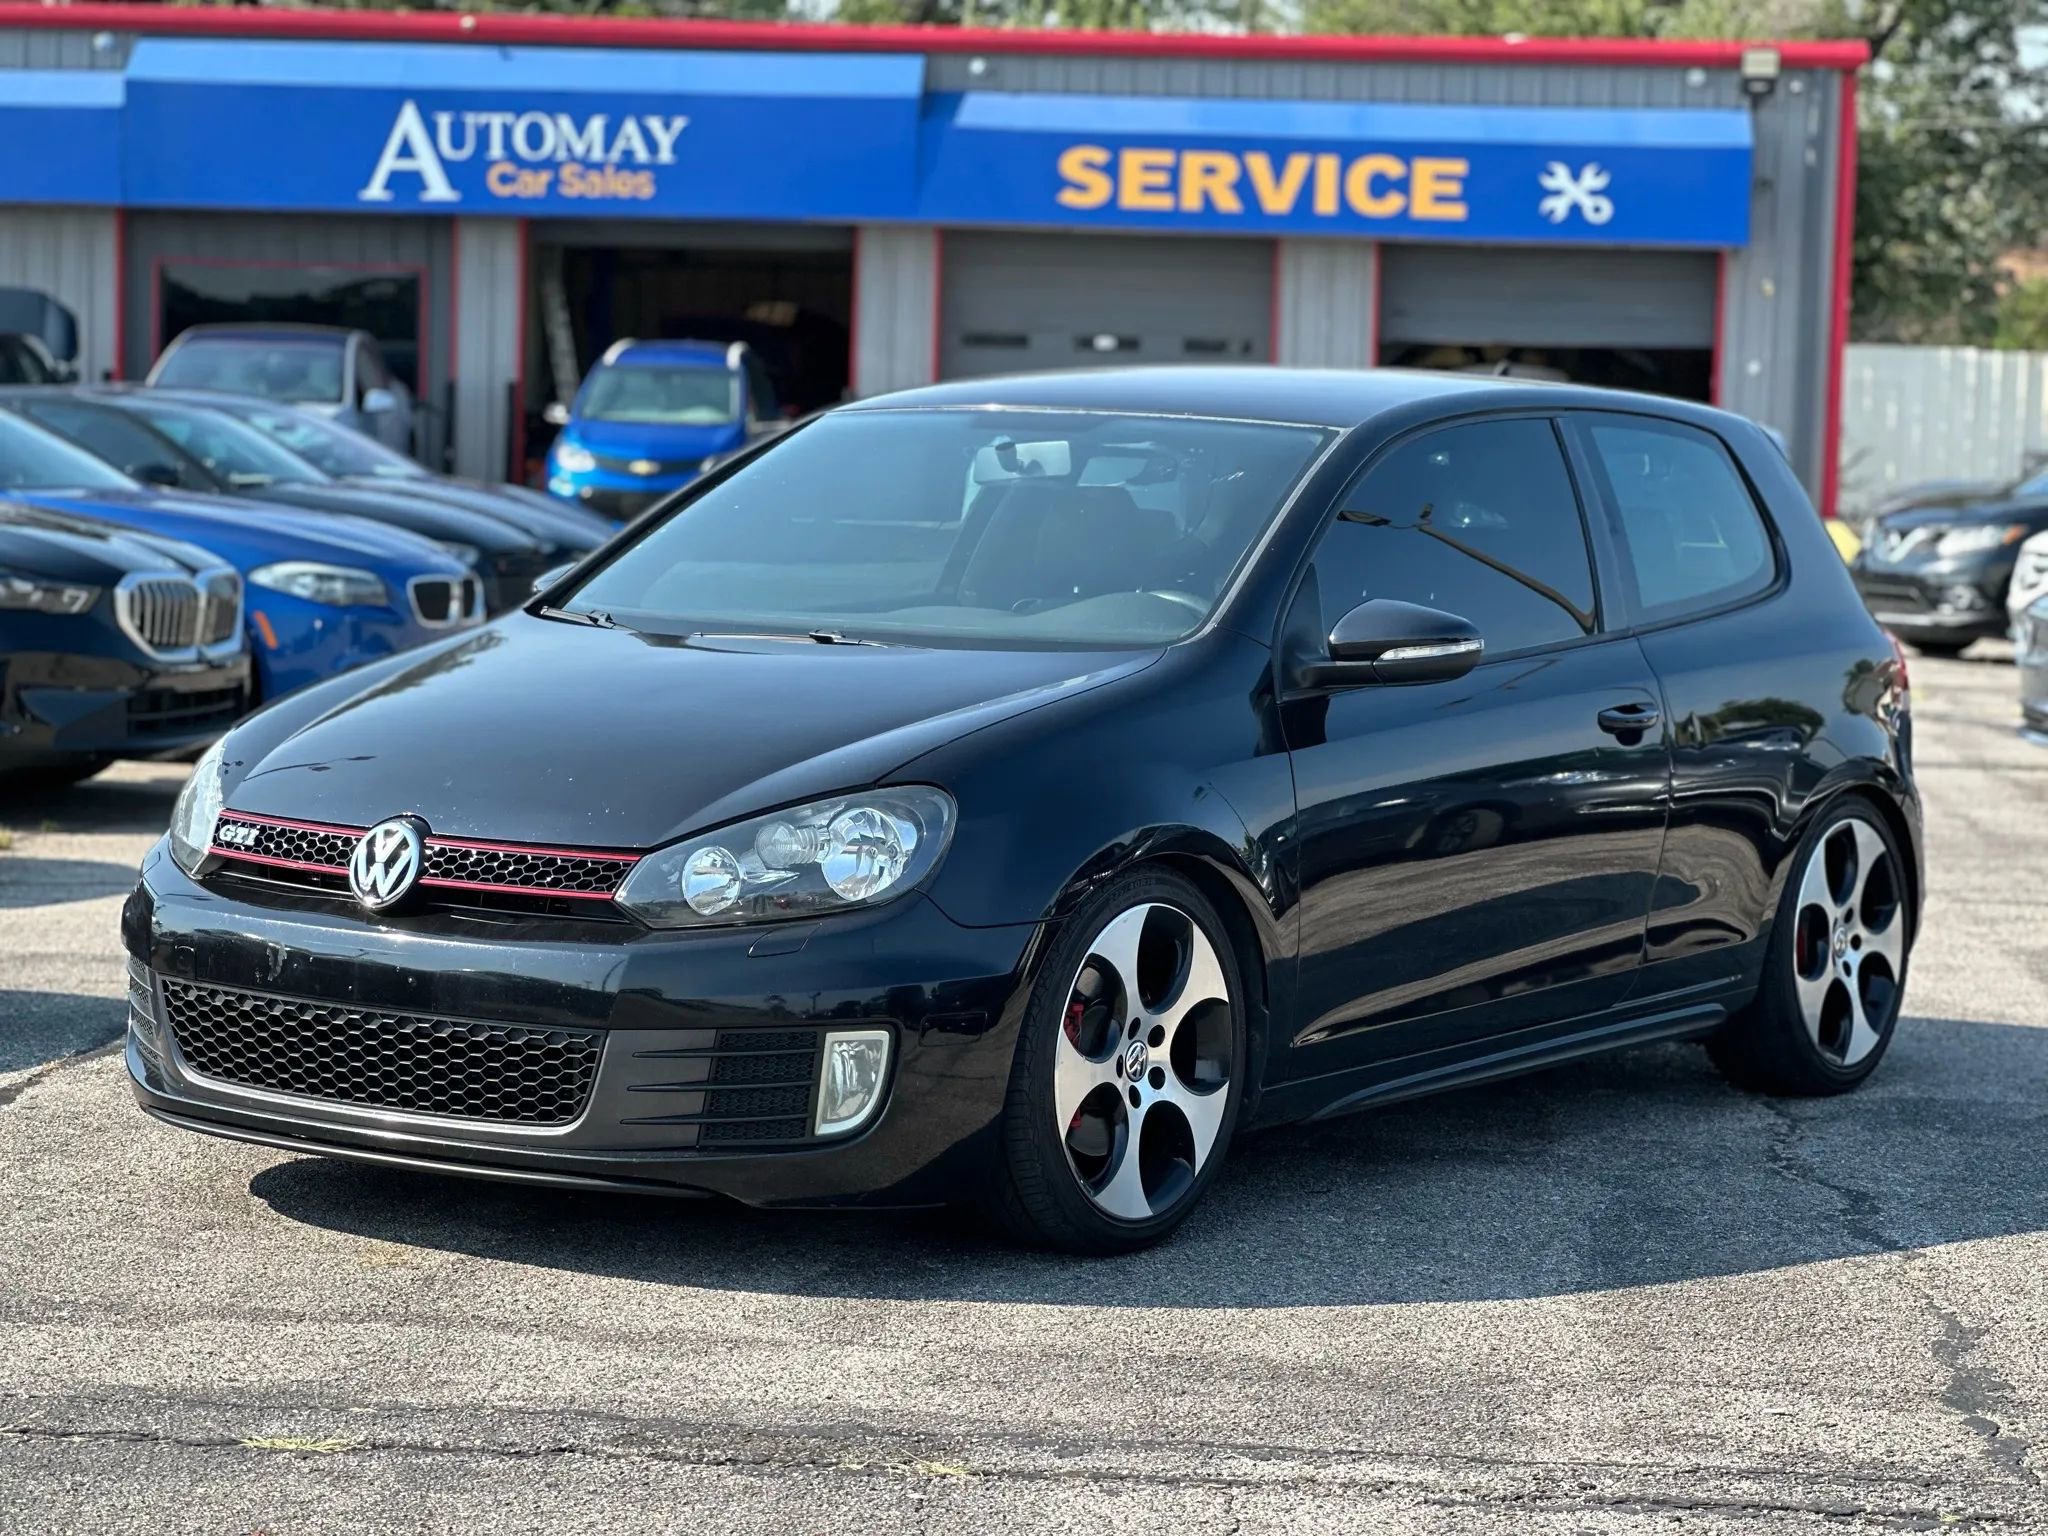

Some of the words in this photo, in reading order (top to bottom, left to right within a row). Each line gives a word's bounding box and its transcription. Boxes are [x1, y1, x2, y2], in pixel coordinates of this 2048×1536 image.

[358, 99, 690, 202] AUTOMAY
[486, 160, 552, 199] Car
[558, 162, 656, 200] Sales
[1056, 144, 1470, 222] SERVICE
[219, 824, 260, 846] GTI
[350, 820, 420, 908] VW
